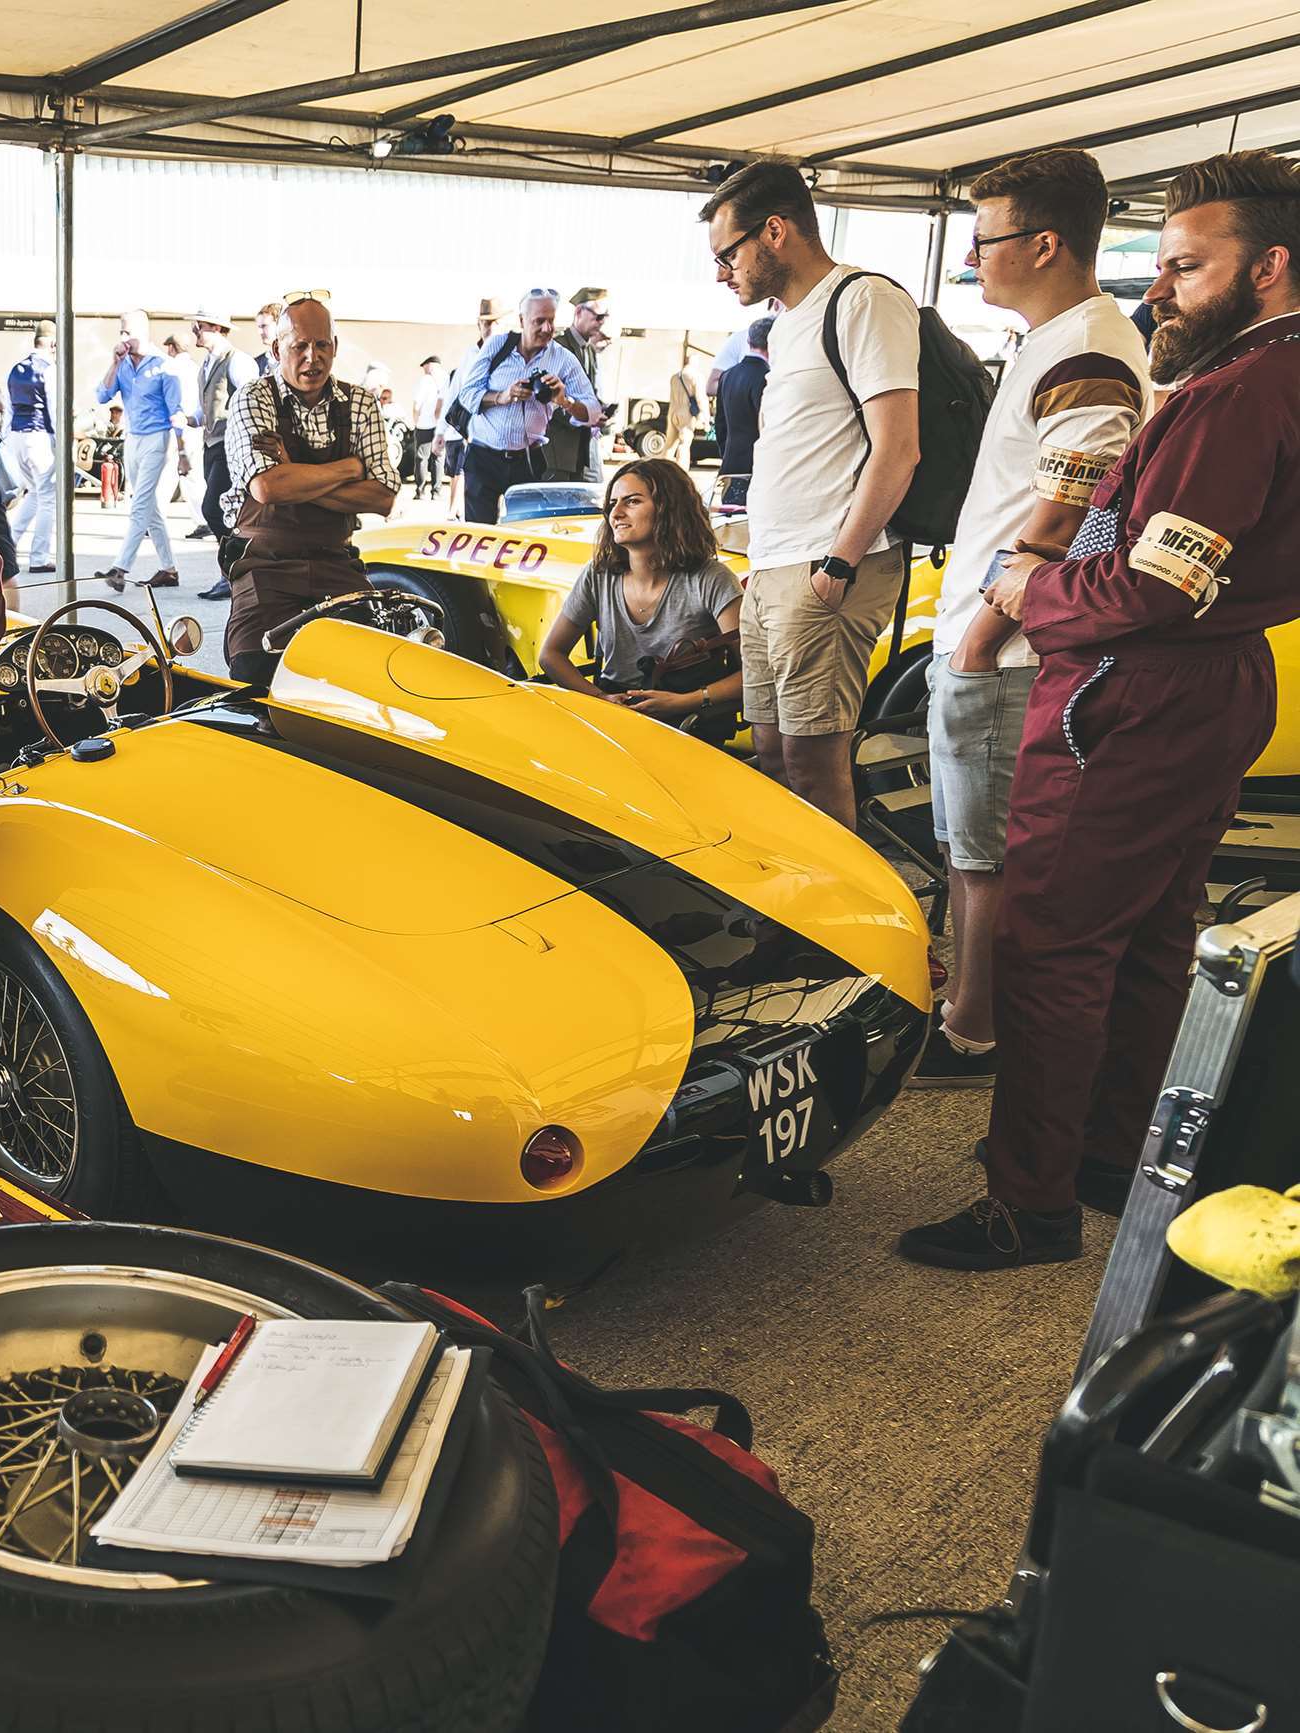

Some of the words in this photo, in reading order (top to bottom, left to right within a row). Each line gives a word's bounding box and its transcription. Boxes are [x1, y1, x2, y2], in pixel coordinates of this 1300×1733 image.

[421, 529, 549, 573] SPEED
[748, 1045, 818, 1112] WSK
[759, 1096, 814, 1165] 197
